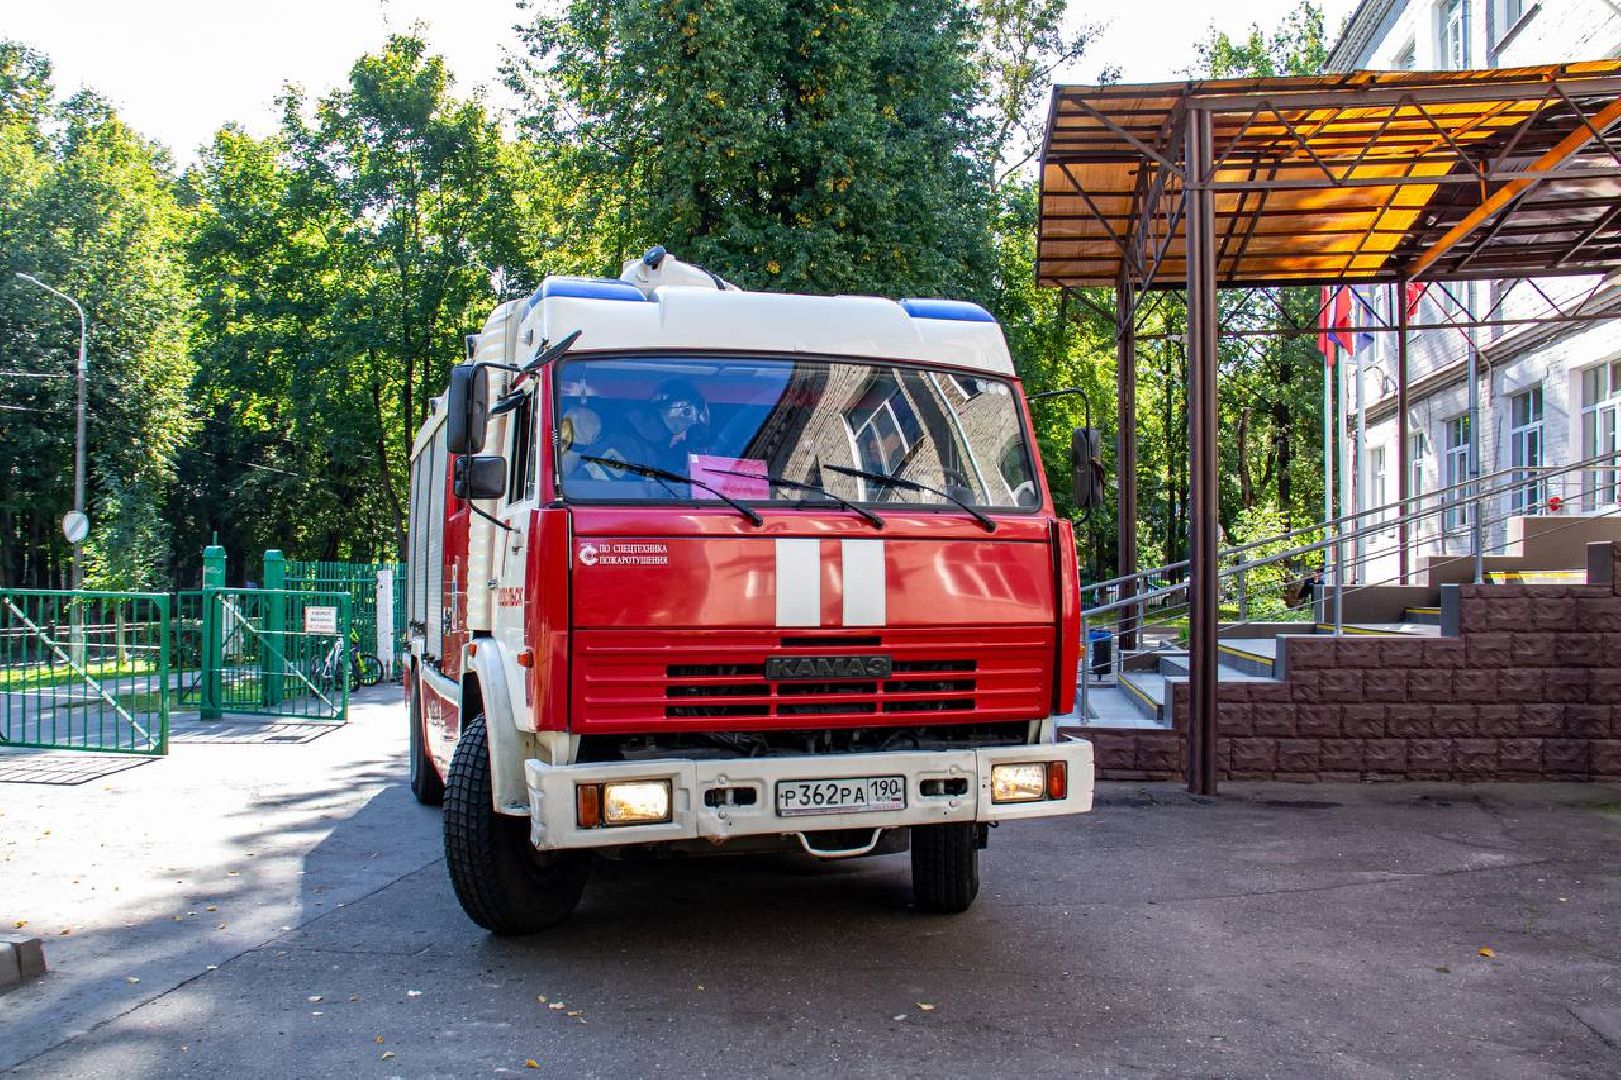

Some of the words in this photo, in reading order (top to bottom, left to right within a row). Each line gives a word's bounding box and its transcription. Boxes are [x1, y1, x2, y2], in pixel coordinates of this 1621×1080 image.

[599, 544, 611, 554] ПО
[613, 544, 668, 555] СПЕЦТЕХНИКА
[599, 556, 668, 565] ПОЖАРОТУШЕНИЯ
[870, 779, 899, 797] 190
